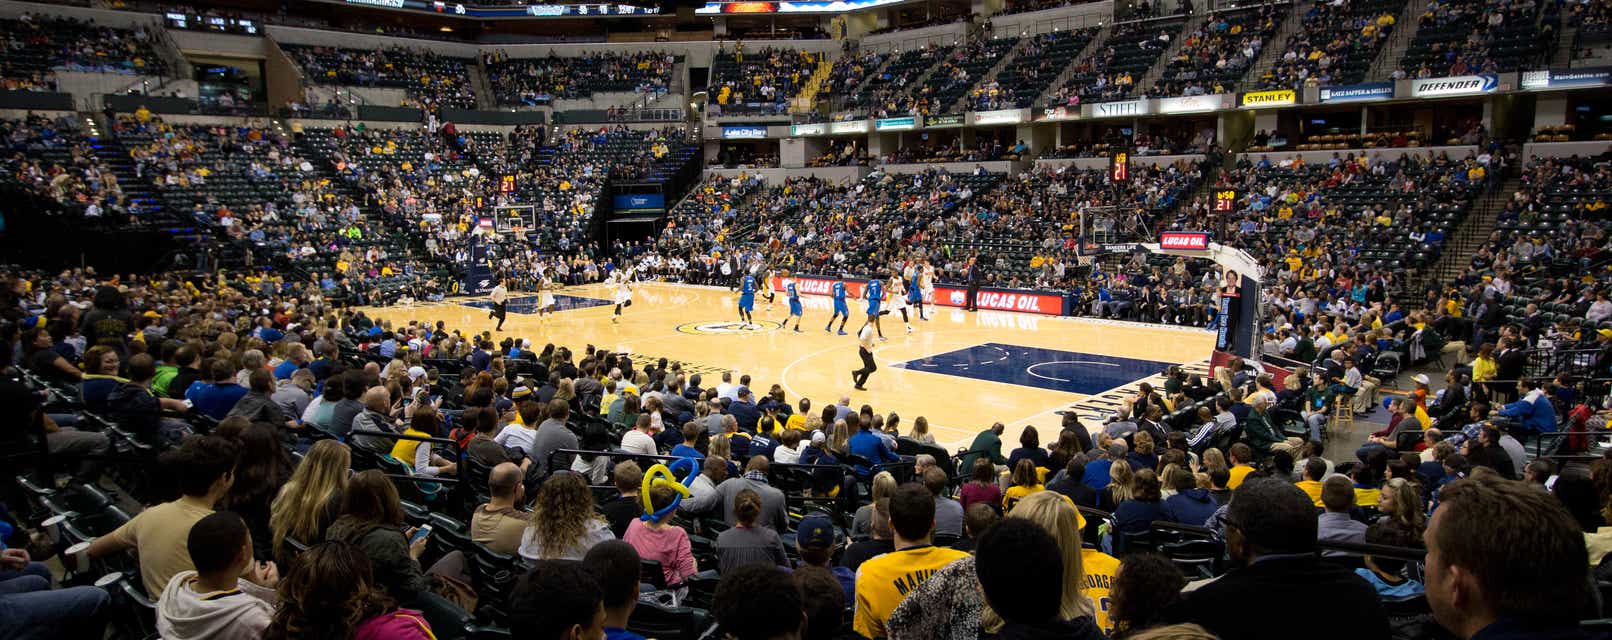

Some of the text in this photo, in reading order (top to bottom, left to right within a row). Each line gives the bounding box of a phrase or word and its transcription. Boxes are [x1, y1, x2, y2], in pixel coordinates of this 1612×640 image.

[1419, 80, 1481, 92] DEFENDER
[1247, 93, 1291, 103] STANLEY
[1100, 102, 1138, 116] STIFEL
[1115, 163, 1126, 180] 21
[502, 181, 514, 191] 21
[1217, 191, 1235, 200] 6:50
[1216, 200, 1231, 211] 21
[1162, 236, 1190, 246] LUCAS
[800, 279, 831, 294] LUCAS
[977, 291, 1014, 308] LUCAS
